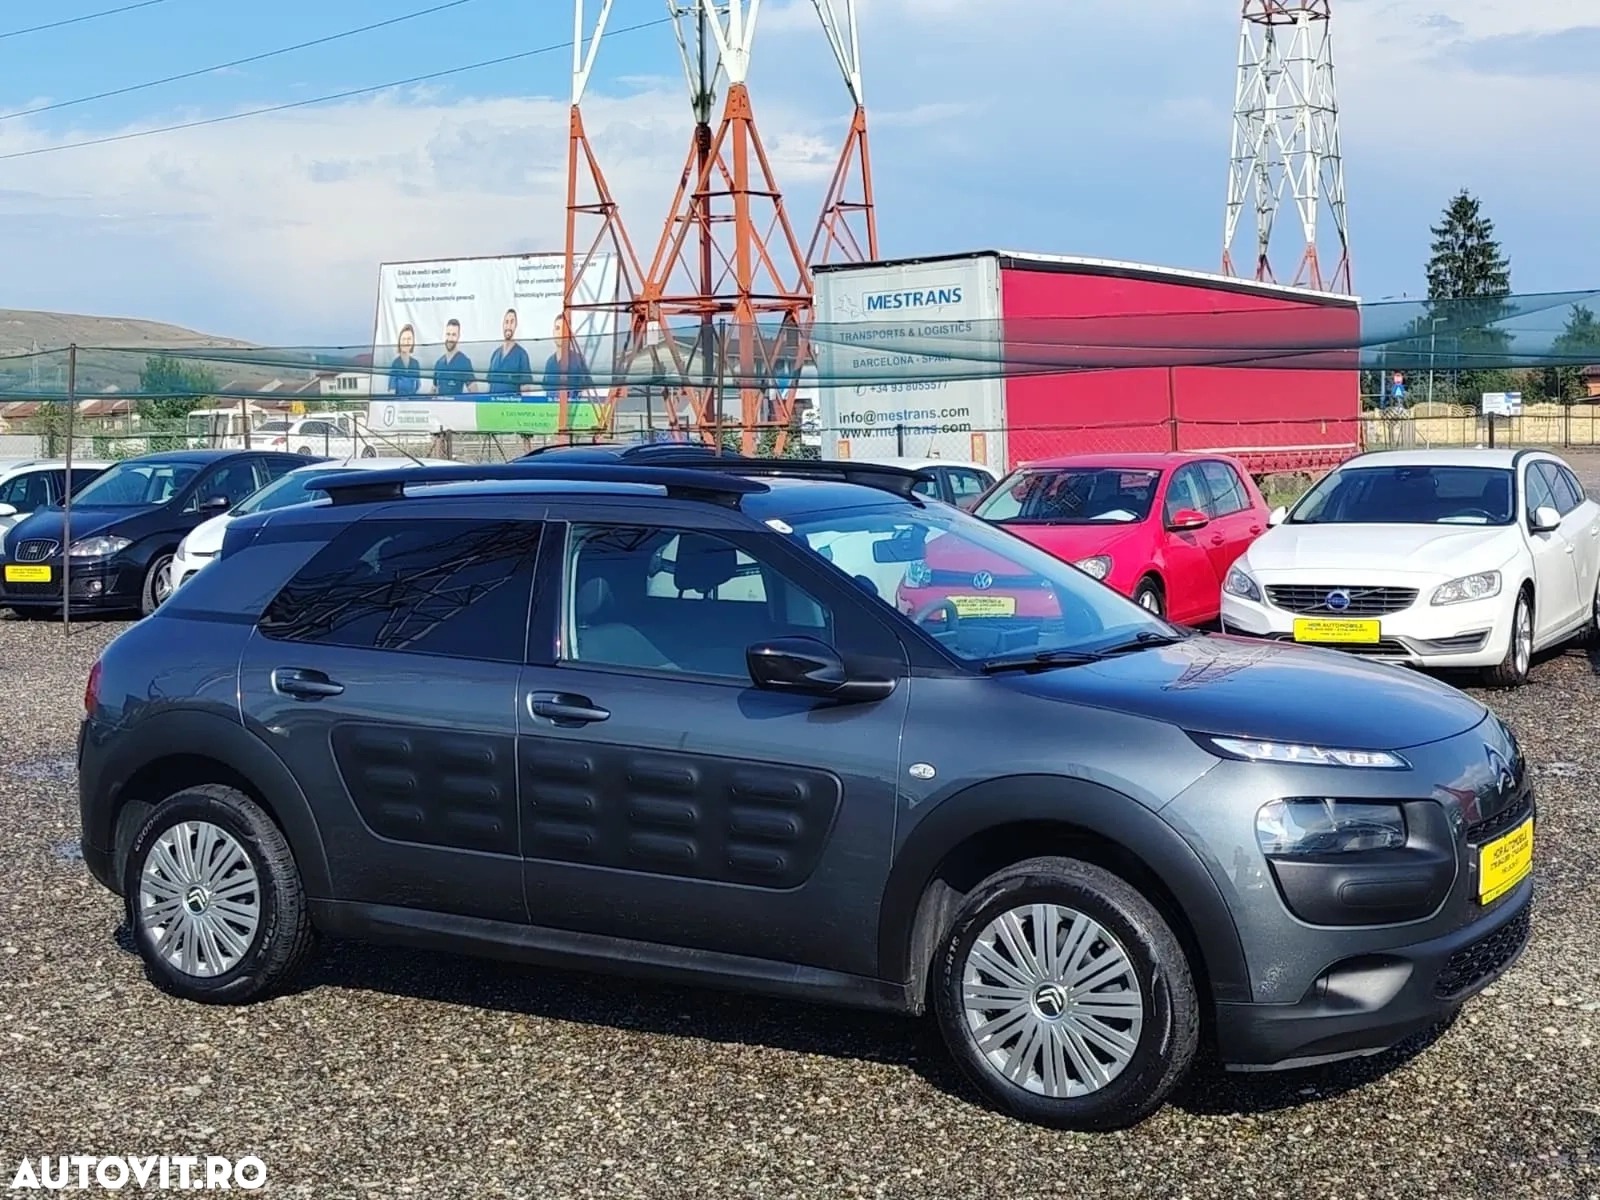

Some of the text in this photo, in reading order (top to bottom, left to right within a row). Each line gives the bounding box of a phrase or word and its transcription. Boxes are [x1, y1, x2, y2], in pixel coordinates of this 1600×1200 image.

[867, 287, 962, 311] MESTRANS
[840, 322, 972, 342] TRANSPORTS & LOGISTICS
[853, 355, 914, 369] BARCELONA
[921, 353, 952, 364] SPAIN
[839, 407, 970, 425] info@mestrans.com
[839, 422, 971, 438] www.metrans.com
